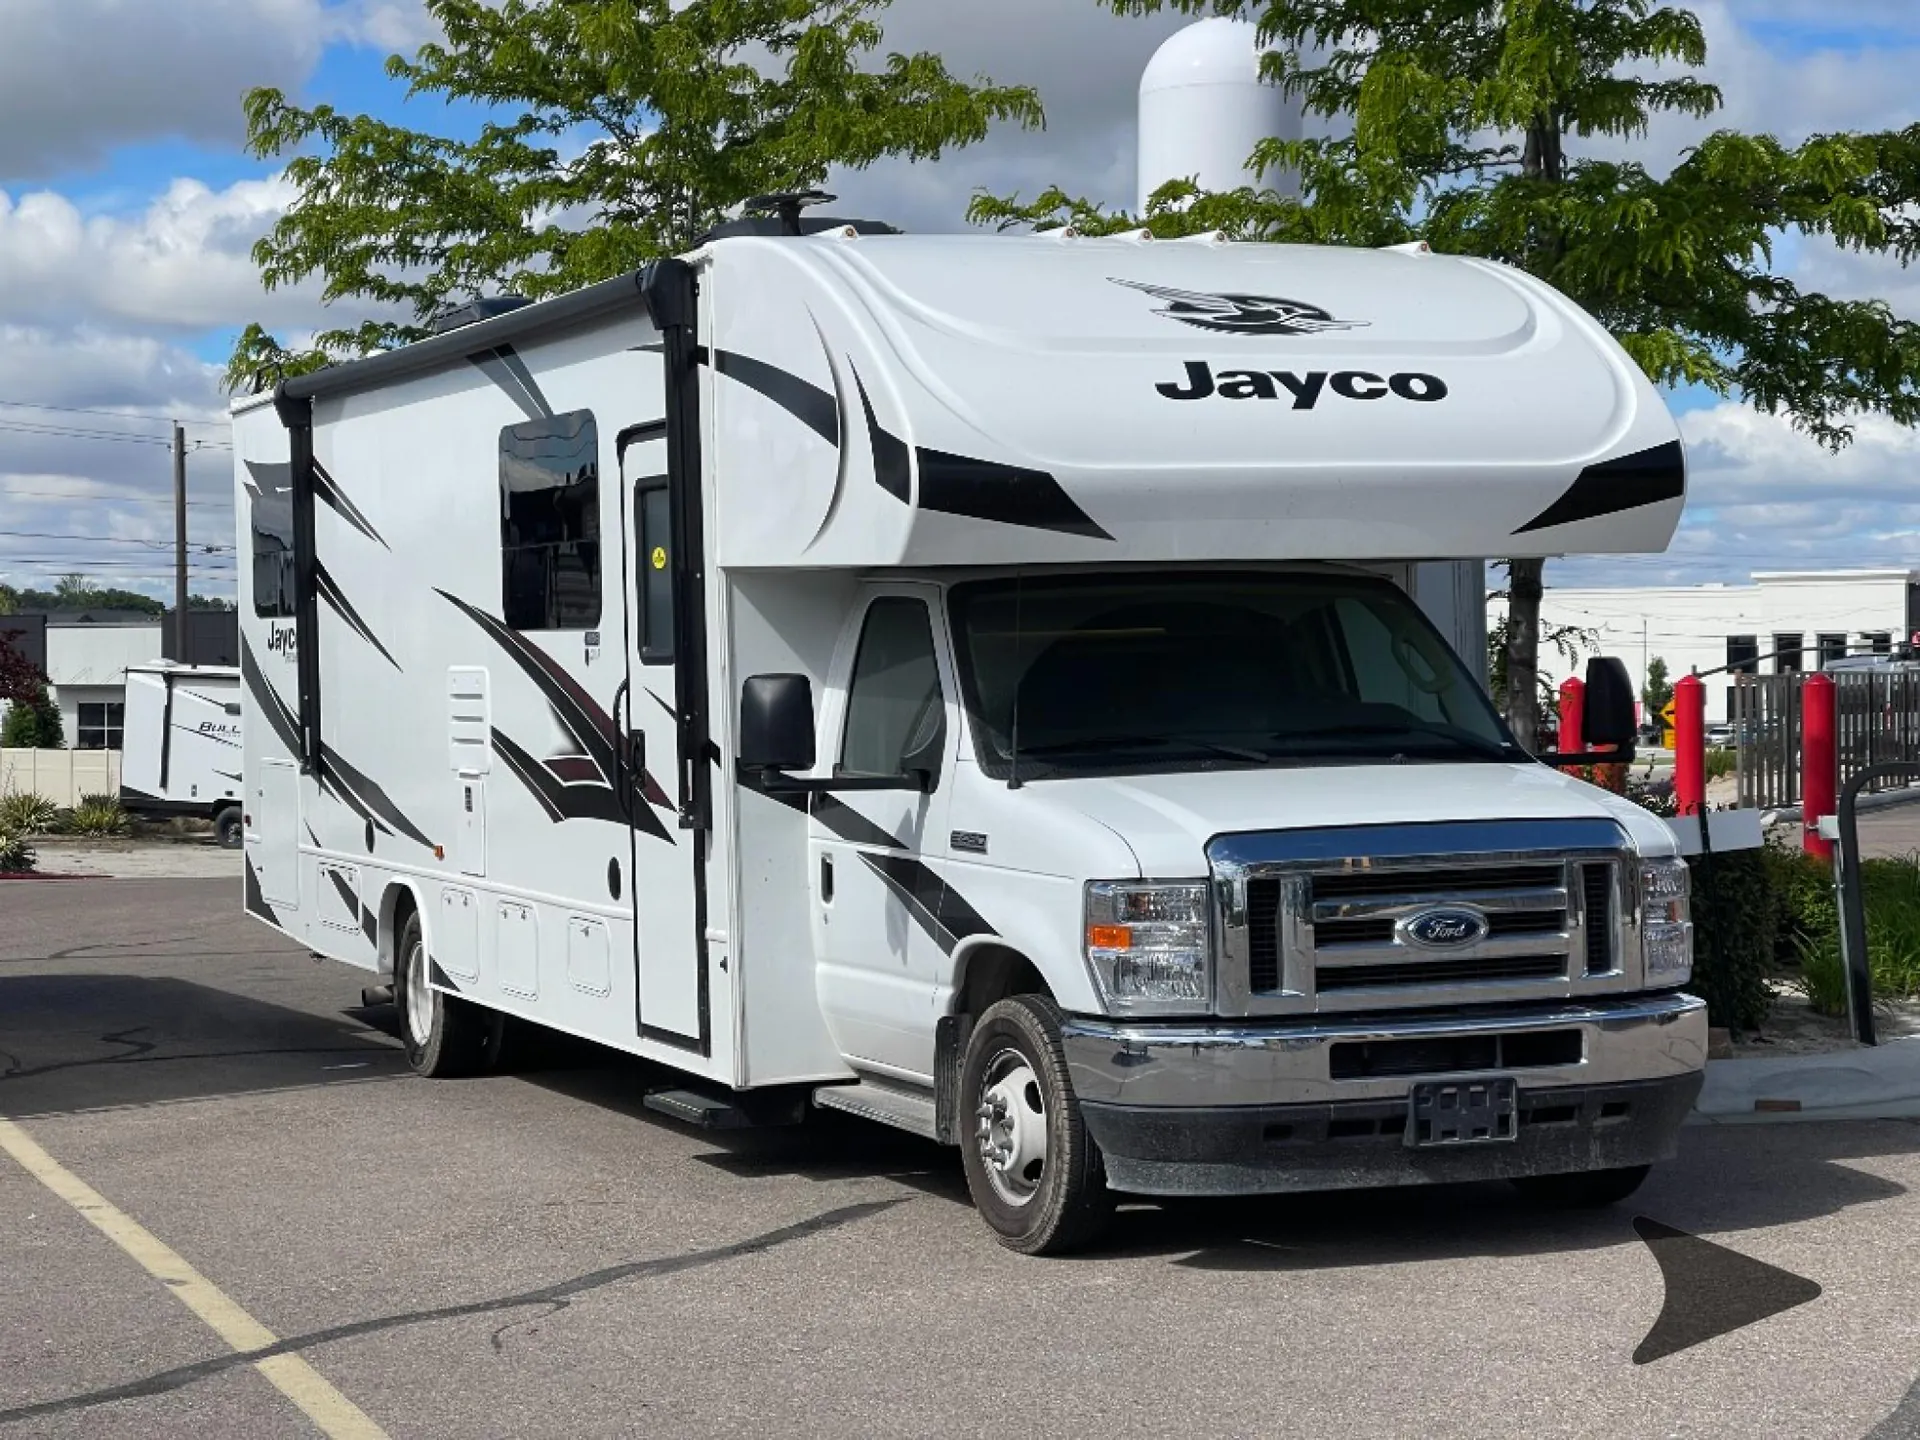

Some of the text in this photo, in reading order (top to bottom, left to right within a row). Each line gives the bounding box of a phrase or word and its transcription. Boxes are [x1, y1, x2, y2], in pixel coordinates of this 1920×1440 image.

[1155, 360, 1448, 410] Jayco
[267, 620, 296, 657] Jayc
[1427, 920, 1467, 938] Ford
